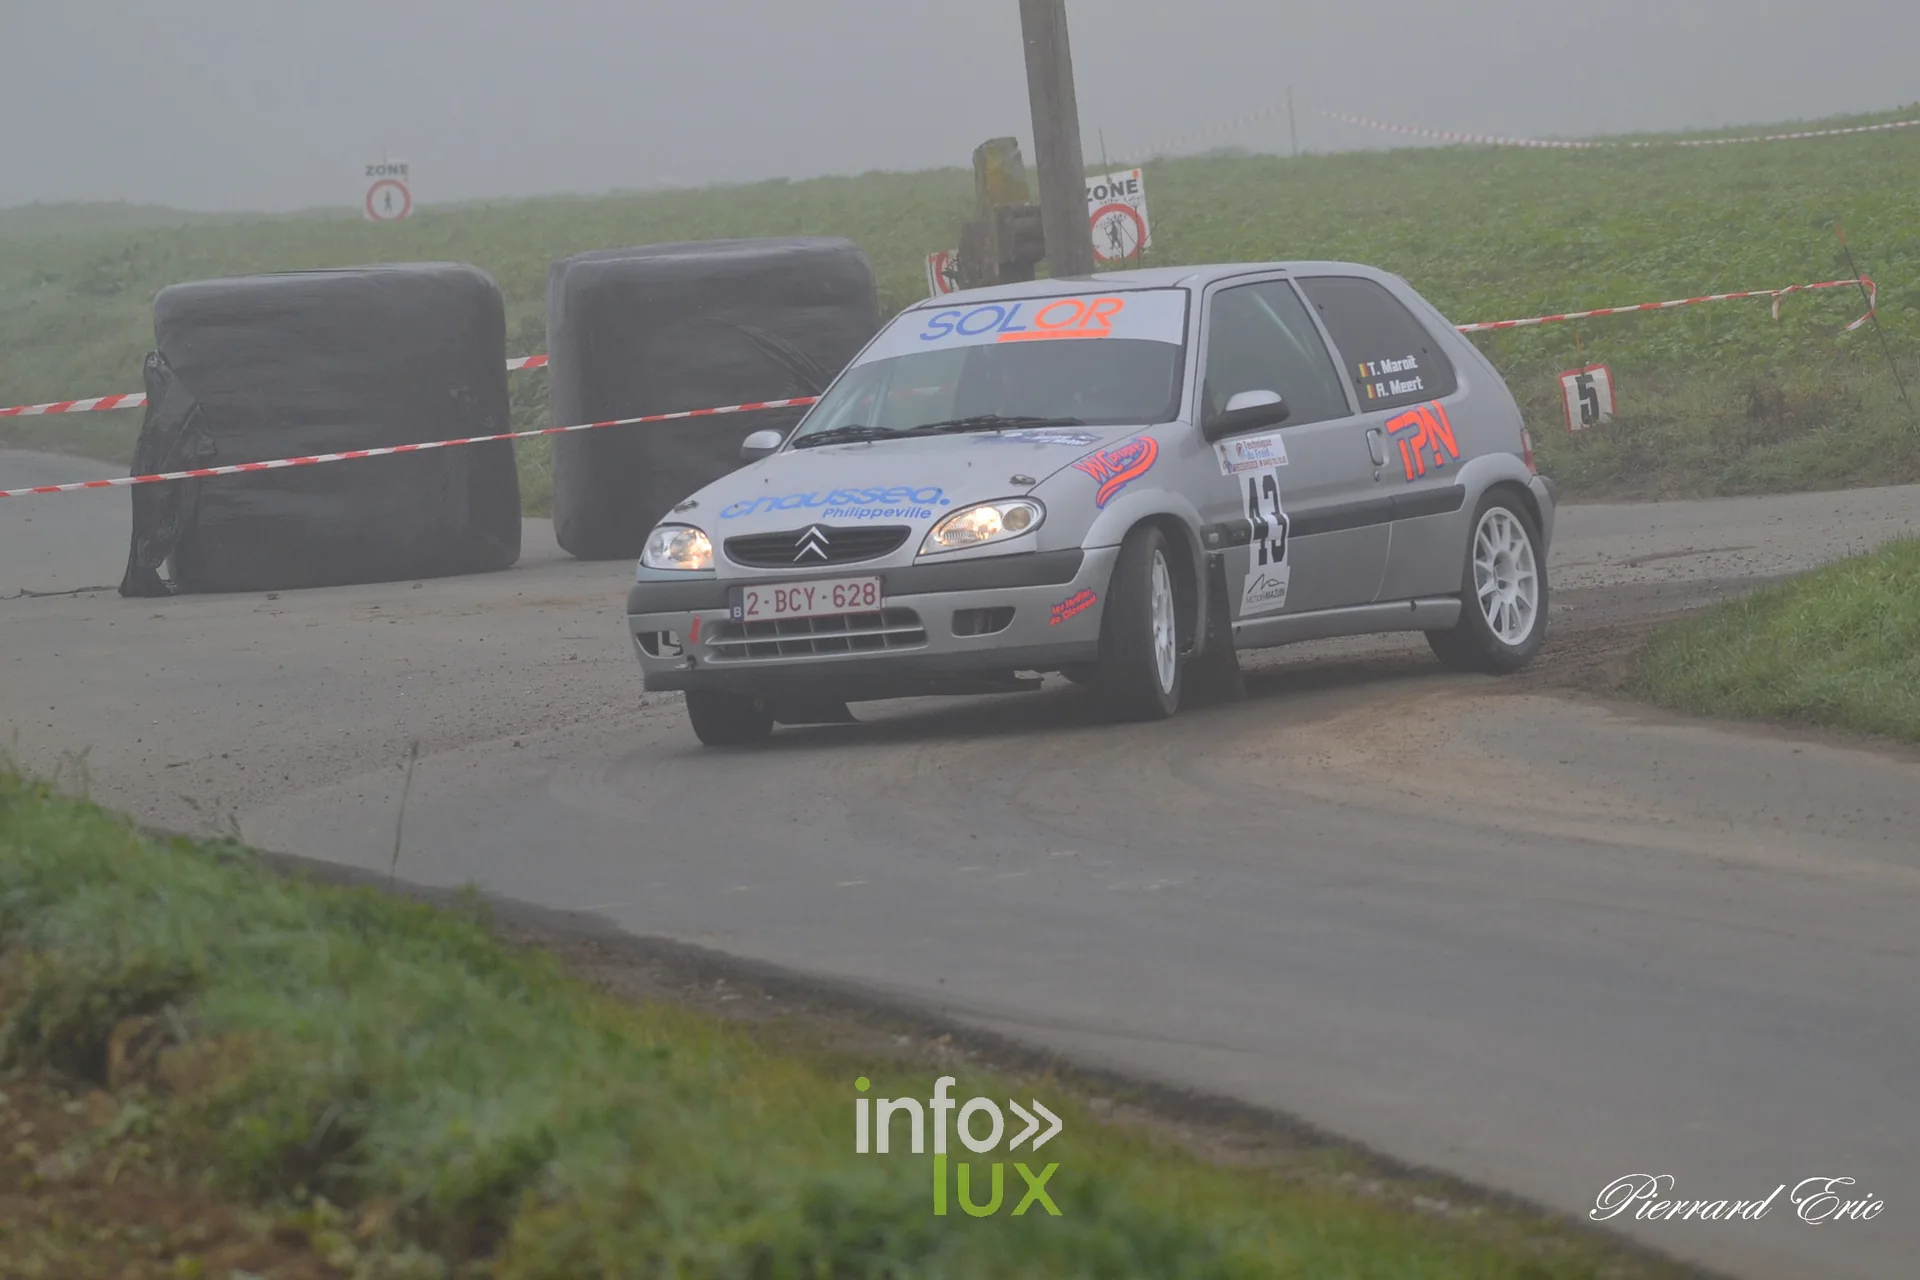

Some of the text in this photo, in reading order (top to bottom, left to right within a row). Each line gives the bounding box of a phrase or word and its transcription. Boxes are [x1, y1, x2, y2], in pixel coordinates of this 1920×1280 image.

[365, 164, 409, 177] ZONE
[920, 297, 1125, 341] SOLOR
[1366, 361, 1381, 377] T.
[1389, 376, 1424, 395] Meert
[1575, 374, 1600, 428] 5
[822, 507, 932, 519] Philippeville
[733, 582, 876, 618] B 2-BCY-628
